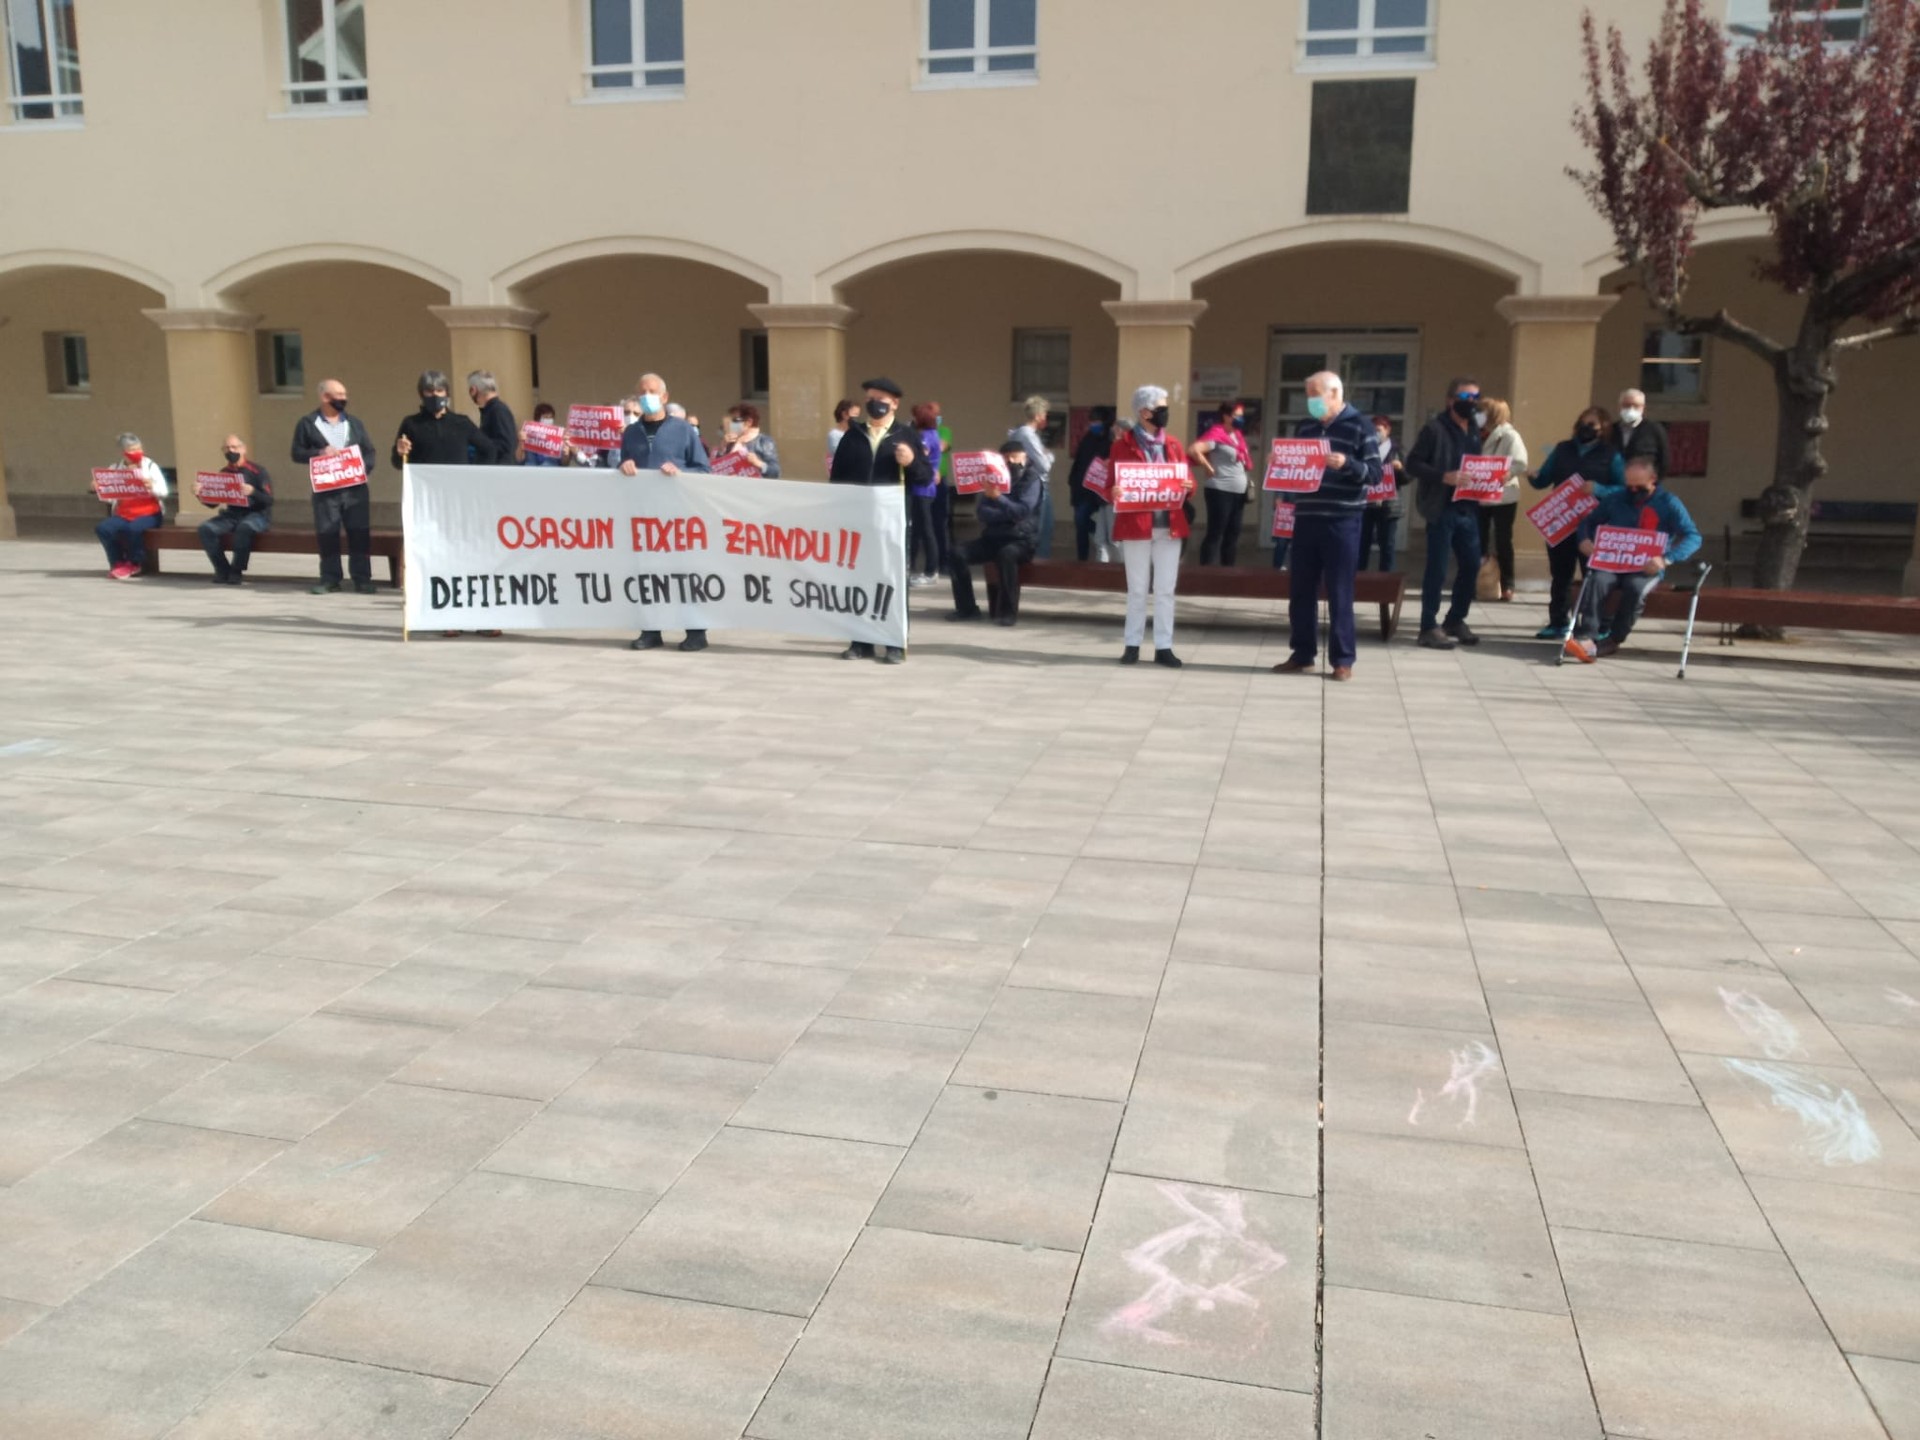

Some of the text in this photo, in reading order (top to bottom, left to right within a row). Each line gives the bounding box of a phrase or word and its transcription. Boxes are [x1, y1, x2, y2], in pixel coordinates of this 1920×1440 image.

[1274, 443, 1319, 455] osasun
[1120, 467, 1174, 479] osasun
[1269, 464, 1322, 480] zaindu
[1120, 478, 1159, 490] etxea
[1119, 488, 1182, 503] zaindu
[1531, 484, 1575, 521] osasun
[1544, 496, 1594, 536] zaindu
[497, 516, 862, 569] OSASUN ETXEA ZAINDU!!
[1600, 531, 1653, 545] osasun
[1598, 540, 1635, 552] etxea
[1594, 550, 1651, 567] zaind
[430, 573, 895, 622] DEFIENDE TU CENTRO DE SALUD!!
